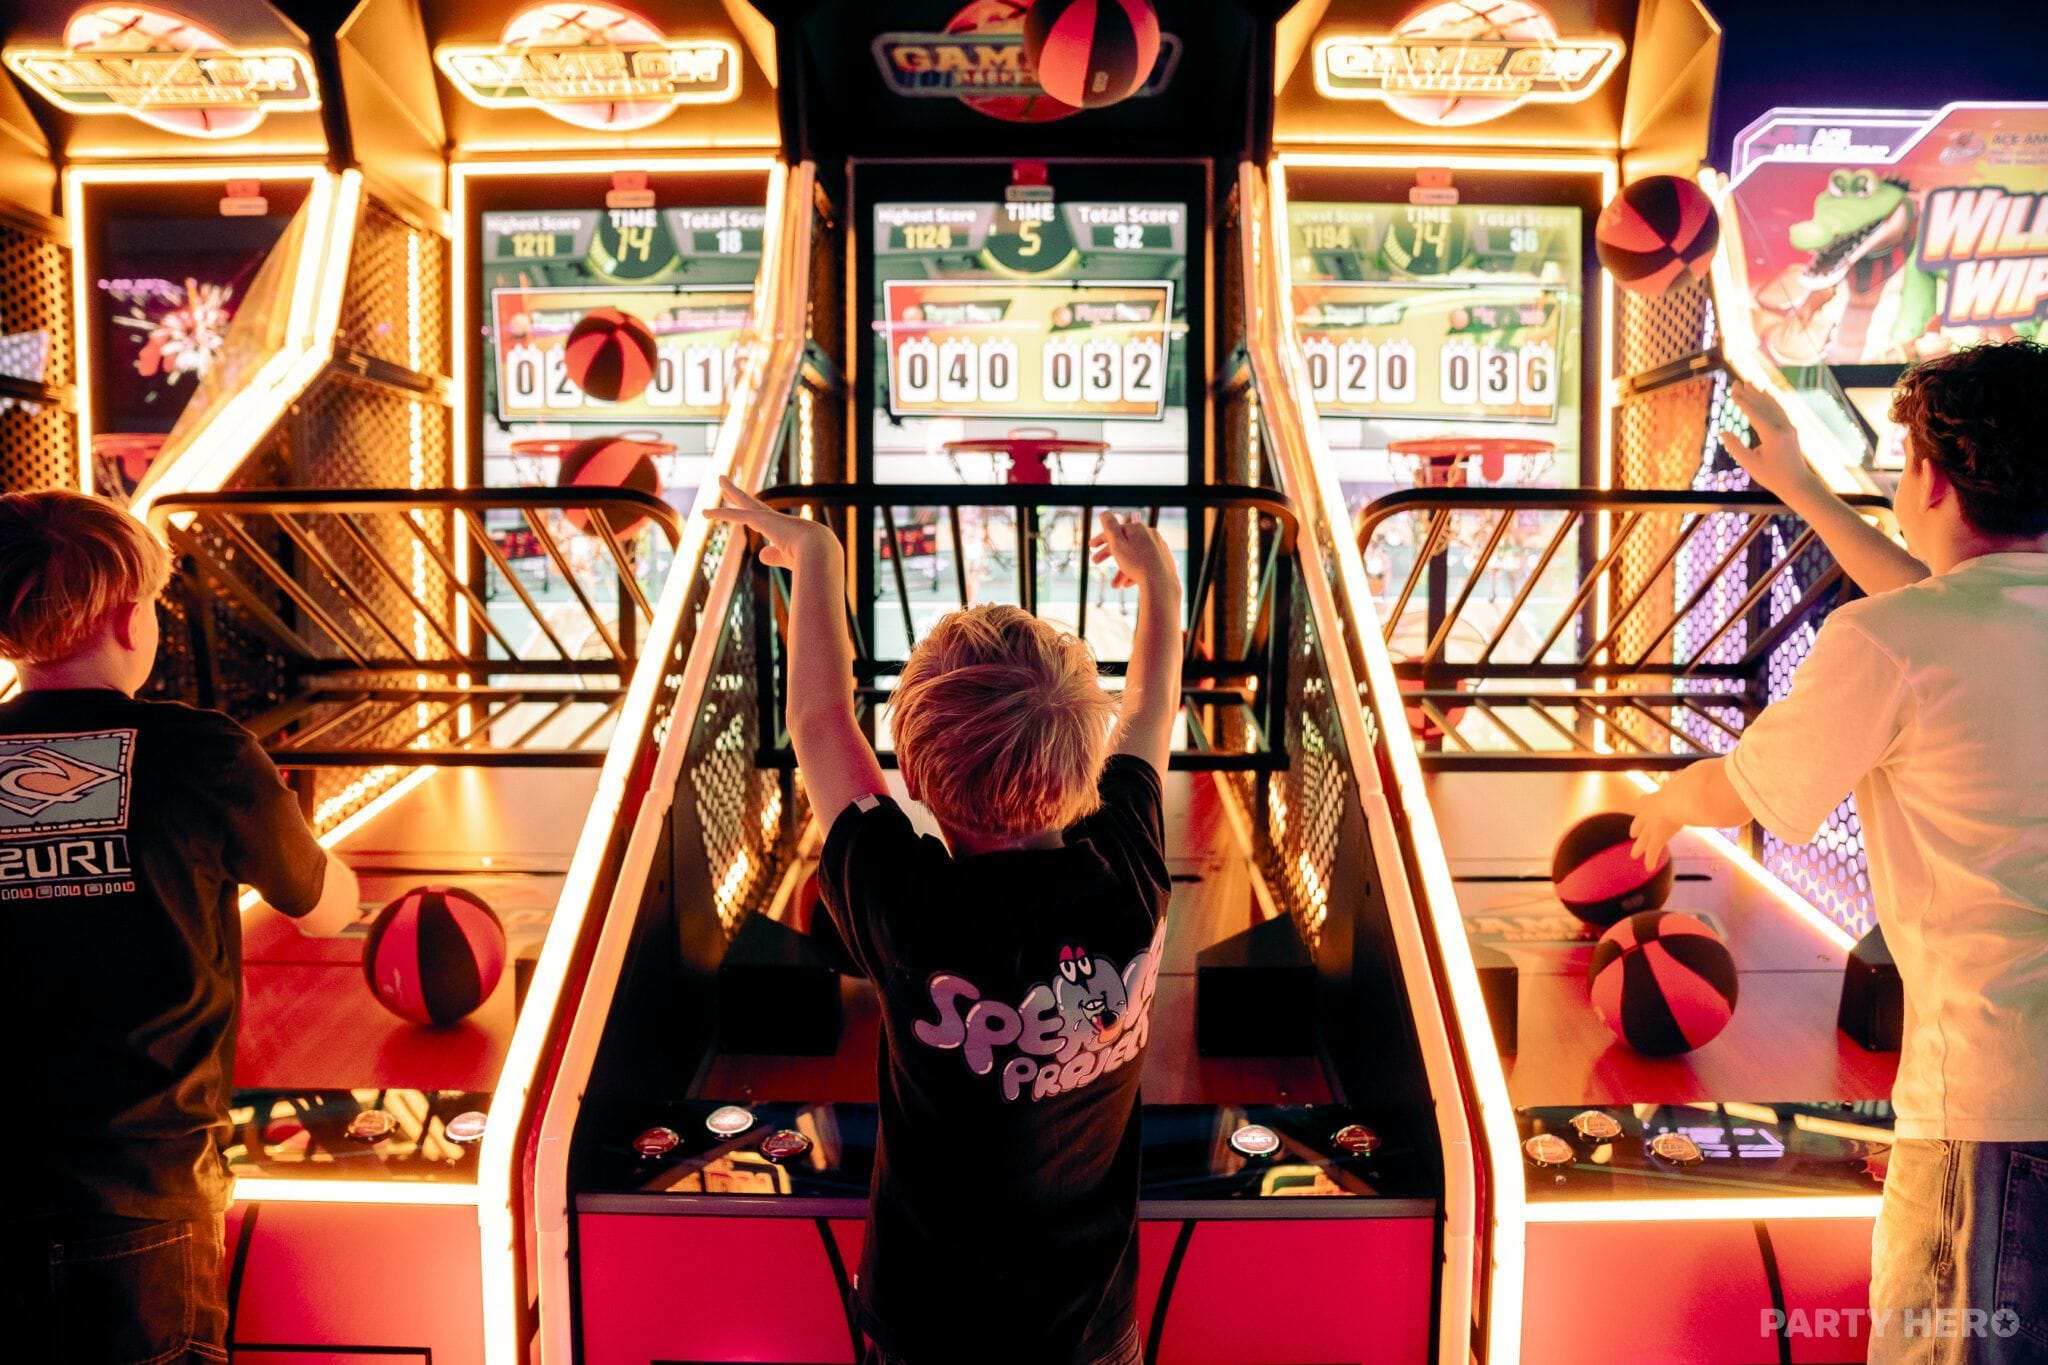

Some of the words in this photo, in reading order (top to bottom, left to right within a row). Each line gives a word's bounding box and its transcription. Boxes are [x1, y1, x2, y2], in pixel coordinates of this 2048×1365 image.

[891, 45, 1026, 73] GAM
[541, 216, 580, 230] Score
[608, 209, 658, 228] TIME
[680, 210, 727, 229] Total
[728, 210, 766, 228] Scor
[878, 208, 935, 226] Highest
[936, 208, 977, 223] Score
[1005, 202, 1055, 221] TIME
[1078, 207, 1128, 224] Total
[1128, 207, 1180, 224] Score
[511, 231, 556, 257] 1211
[615, 227, 653, 262] 14
[902, 225, 952, 249] 1124
[1018, 221, 1042, 256] 5
[1113, 225, 1144, 249] 32
[1411, 222, 1449, 258] 14
[517, 359, 573, 395] 02
[908, 353, 1009, 389] 040
[1052, 353, 1152, 389] 032
[1309, 353, 1408, 390] 020
[1450, 355, 1548, 392] 036
